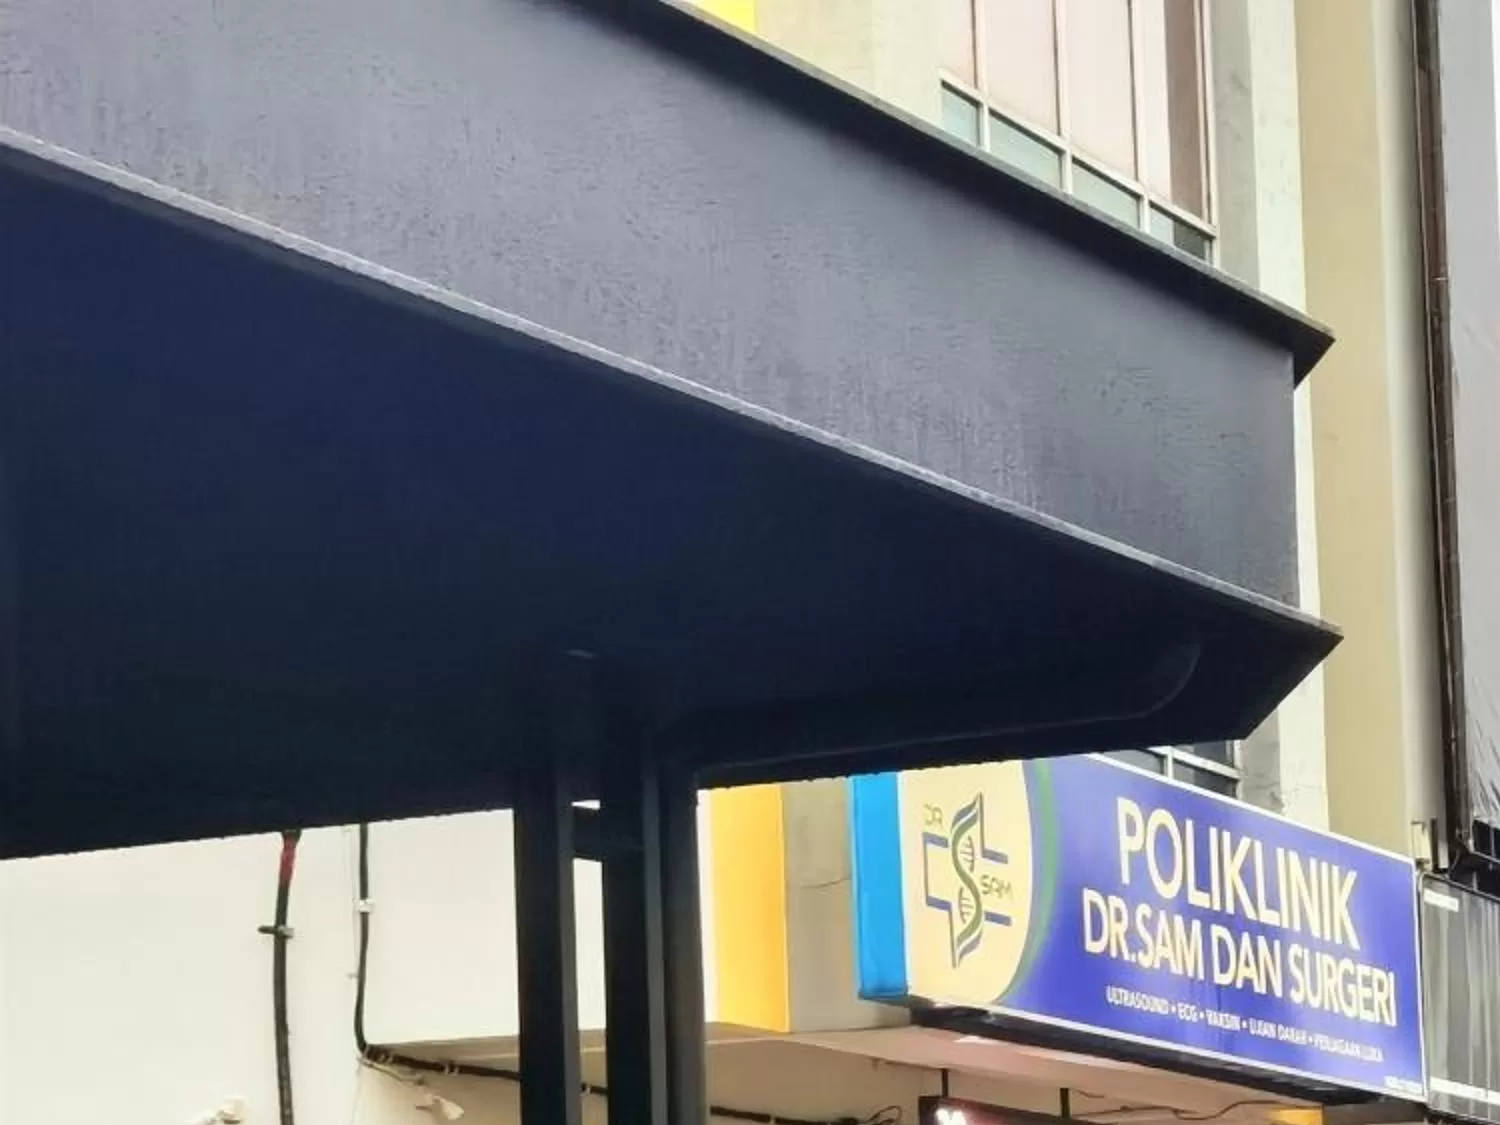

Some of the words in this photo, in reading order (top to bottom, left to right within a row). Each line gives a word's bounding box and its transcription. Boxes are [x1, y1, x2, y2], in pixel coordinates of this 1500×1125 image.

[1117, 797, 1361, 951] POLIKLINIK
[1082, 887, 1204, 983] DR.SAM
[1210, 925, 1284, 1003] DAN
[1289, 946, 1398, 1028] SURGERI
